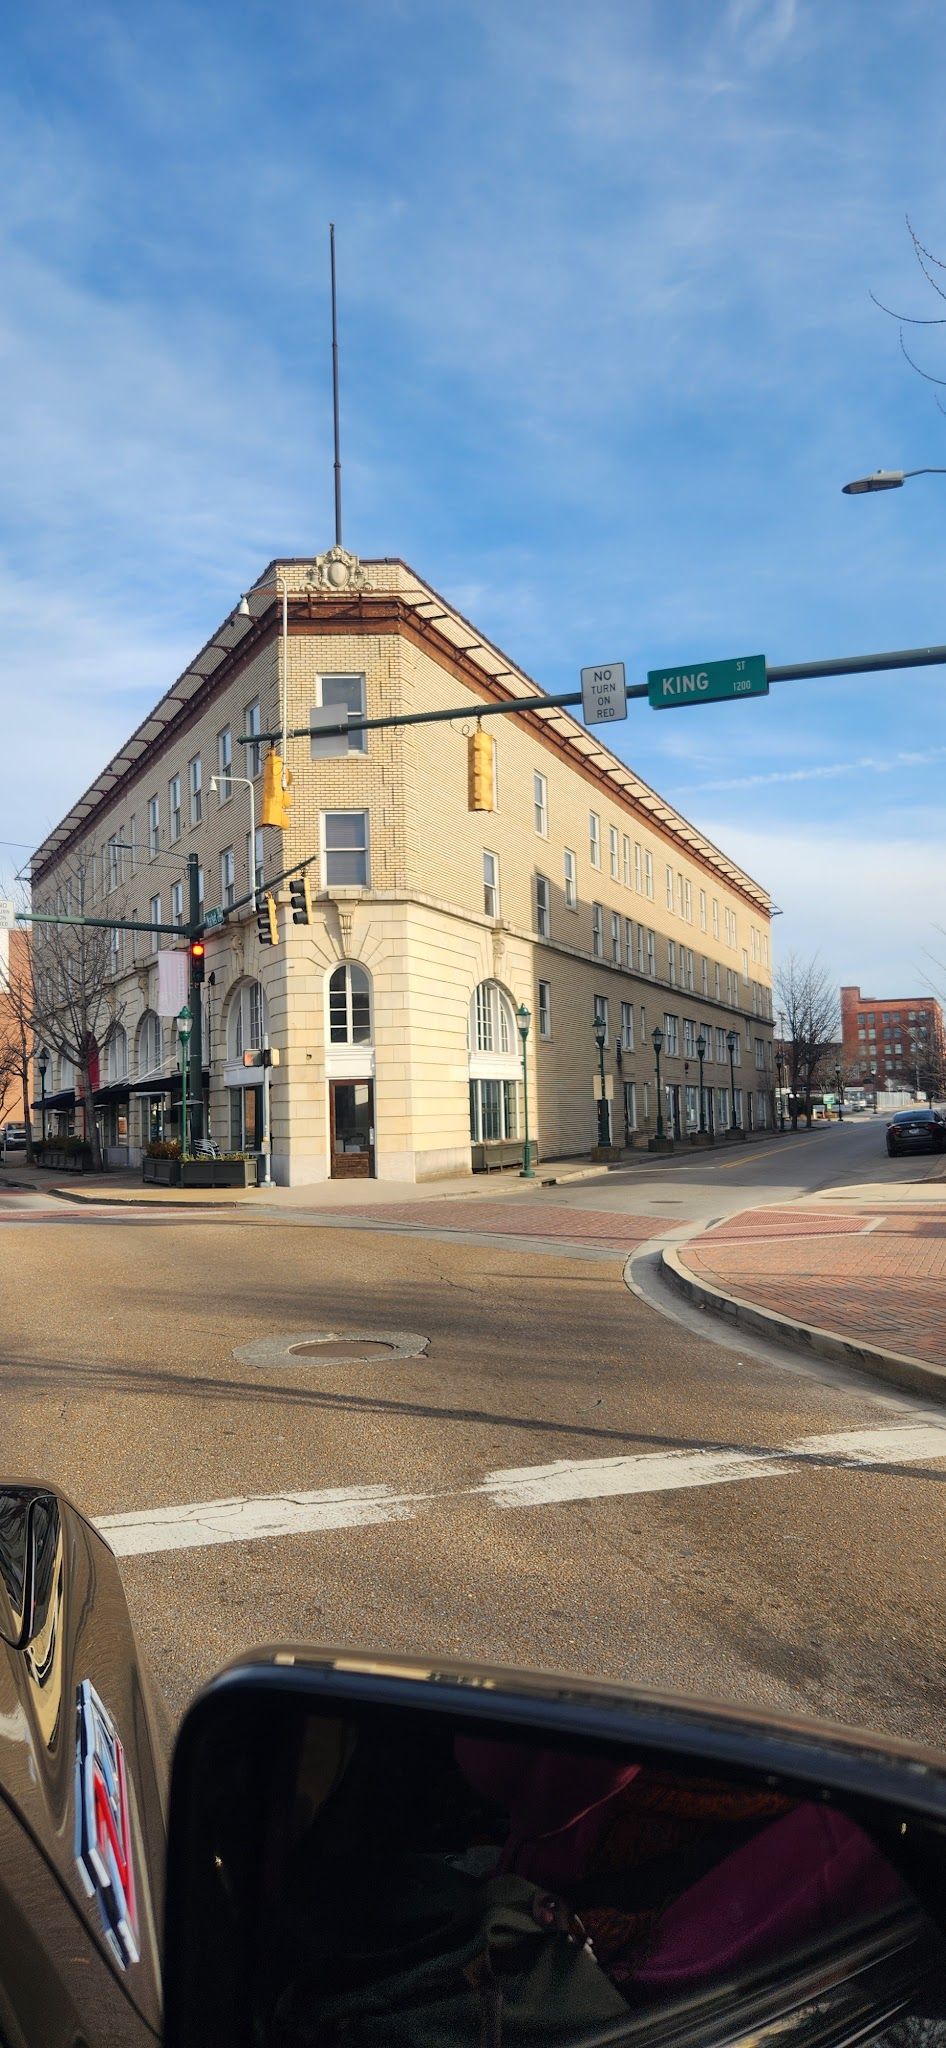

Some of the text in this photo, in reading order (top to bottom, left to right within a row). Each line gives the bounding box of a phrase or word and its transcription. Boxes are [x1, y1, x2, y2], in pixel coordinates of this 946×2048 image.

[736, 661, 746, 671] ST
[594, 670, 612, 682] NO
[591, 683, 616, 695] TURN
[662, 672, 709, 695] KING
[733, 680, 751, 691] 1200
[597, 696, 611, 706] ON
[596, 708, 615, 718] RED
